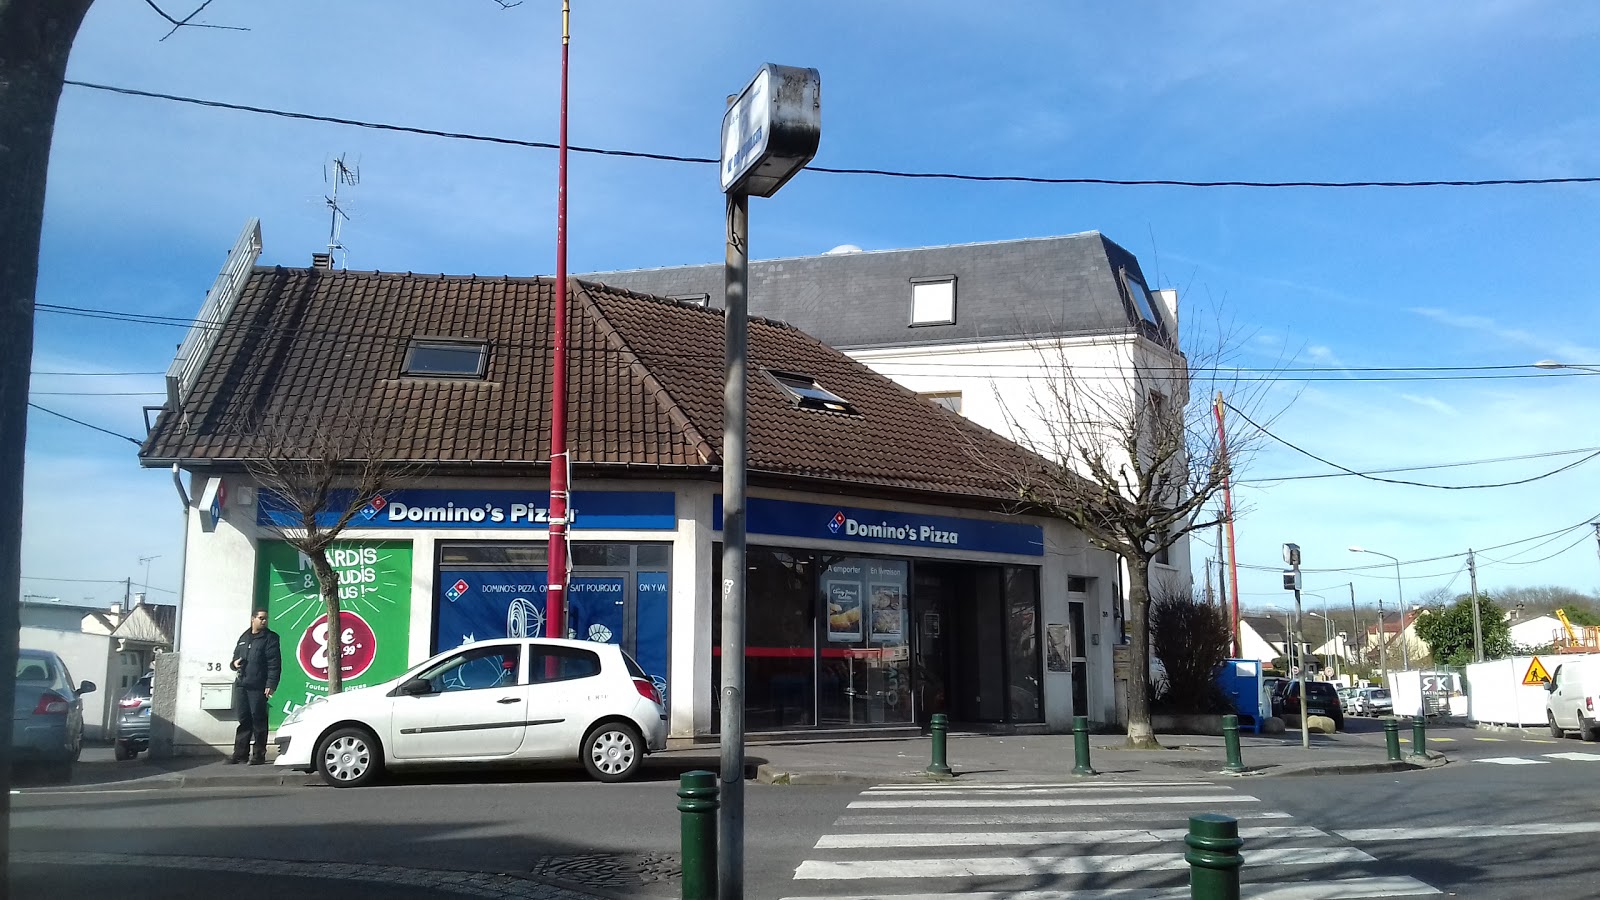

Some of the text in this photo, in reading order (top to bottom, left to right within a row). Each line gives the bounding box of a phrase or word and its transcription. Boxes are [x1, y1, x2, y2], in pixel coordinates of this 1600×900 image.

[388, 501, 575, 523] Domino's Piz
[845, 518, 959, 545] Domino's Pizza
[303, 573, 316, 589] &
[482, 584, 516, 593] DOMINO'S
[569, 584, 585, 592] SAIT
[586, 584, 622, 592] POURQUOI
[639, 583, 650, 592] ON
[206, 662, 222, 672] 38
[305, 682, 329, 692] Toutes
